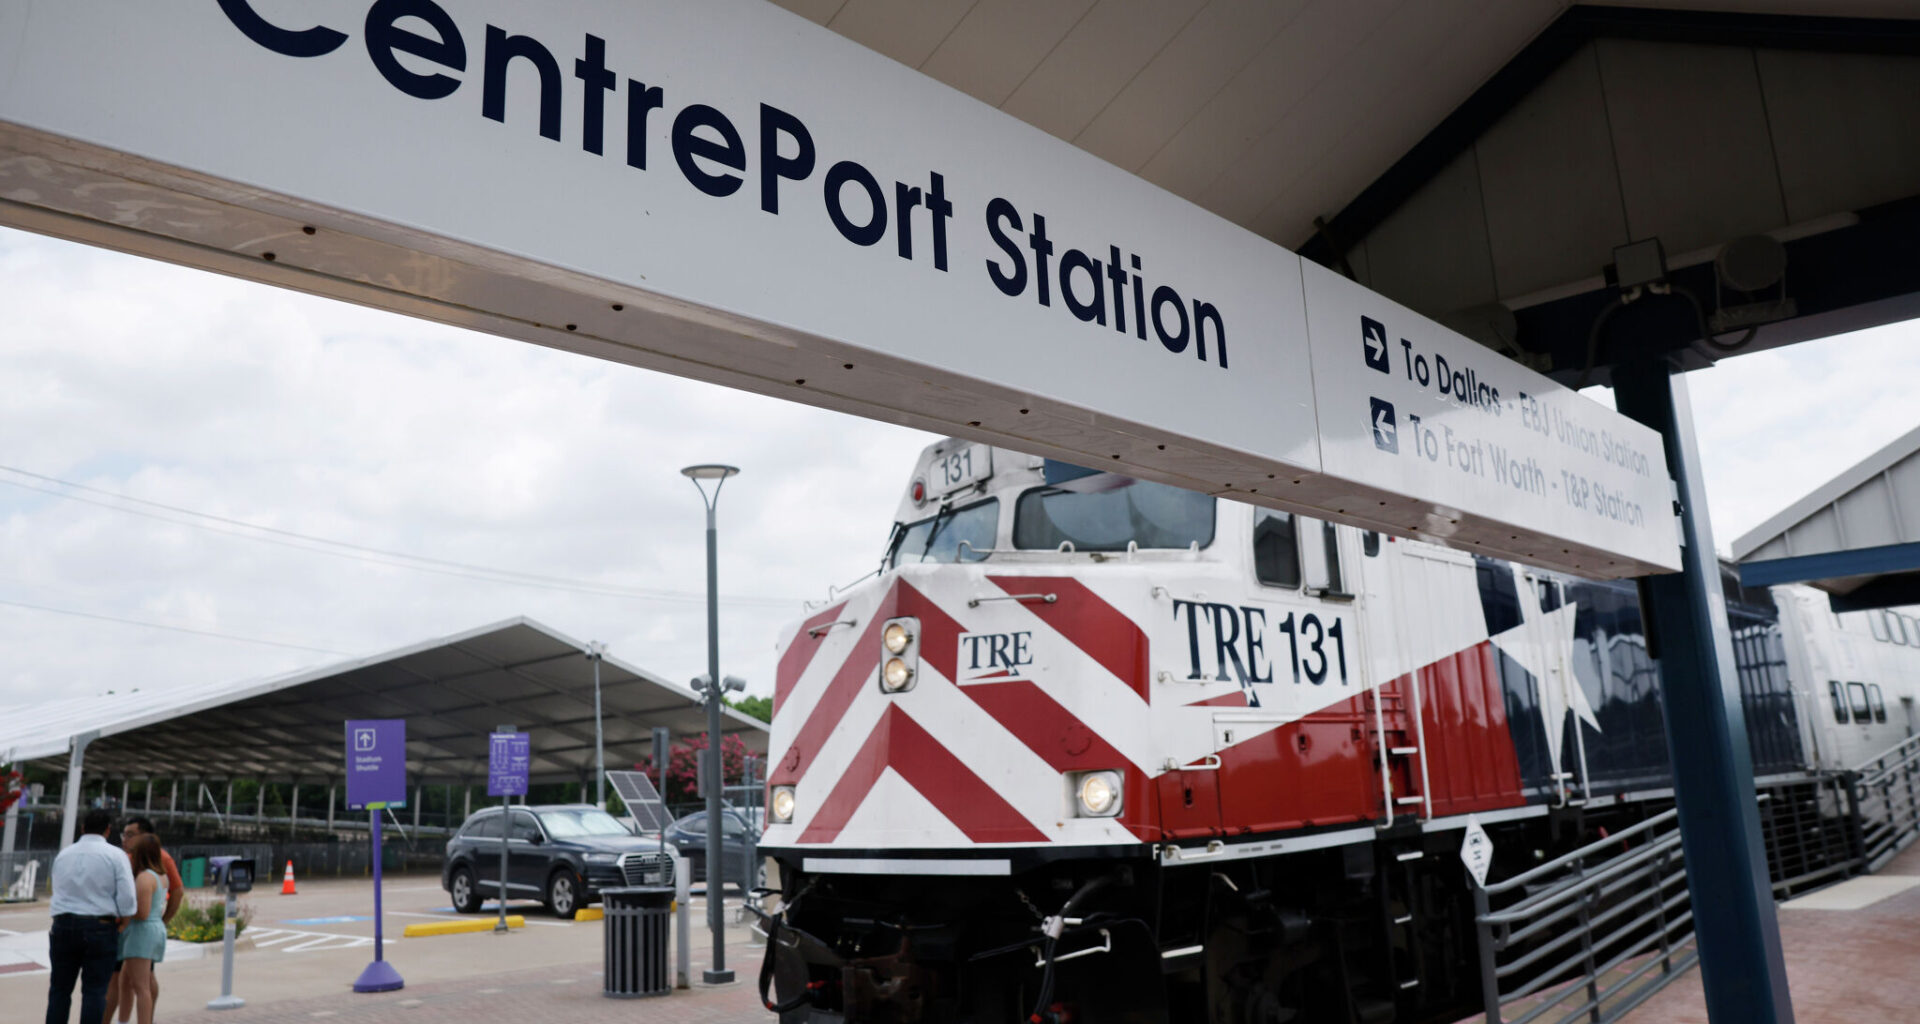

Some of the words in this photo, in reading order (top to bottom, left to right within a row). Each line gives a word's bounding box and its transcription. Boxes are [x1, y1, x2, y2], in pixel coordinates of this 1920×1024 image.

[985, 197, 1229, 370] Station
[1400, 338, 1430, 388] To
[1435, 353, 1502, 417] Dallas
[1519, 391, 1549, 437] EBJ
[1553, 407, 1600, 458] Union
[1601, 429, 1650, 478] Station
[941, 448, 972, 486] 131
[1409, 413, 1439, 462] To
[1443, 424, 1484, 478] Fort
[1488, 442, 1547, 498] Worth
[1561, 469, 1589, 510] T&P
[1593, 481, 1645, 529] Station
[963, 631, 1033, 676] TRE
[1173, 599, 1273, 707] TRE
[1279, 611, 1348, 686] 131
